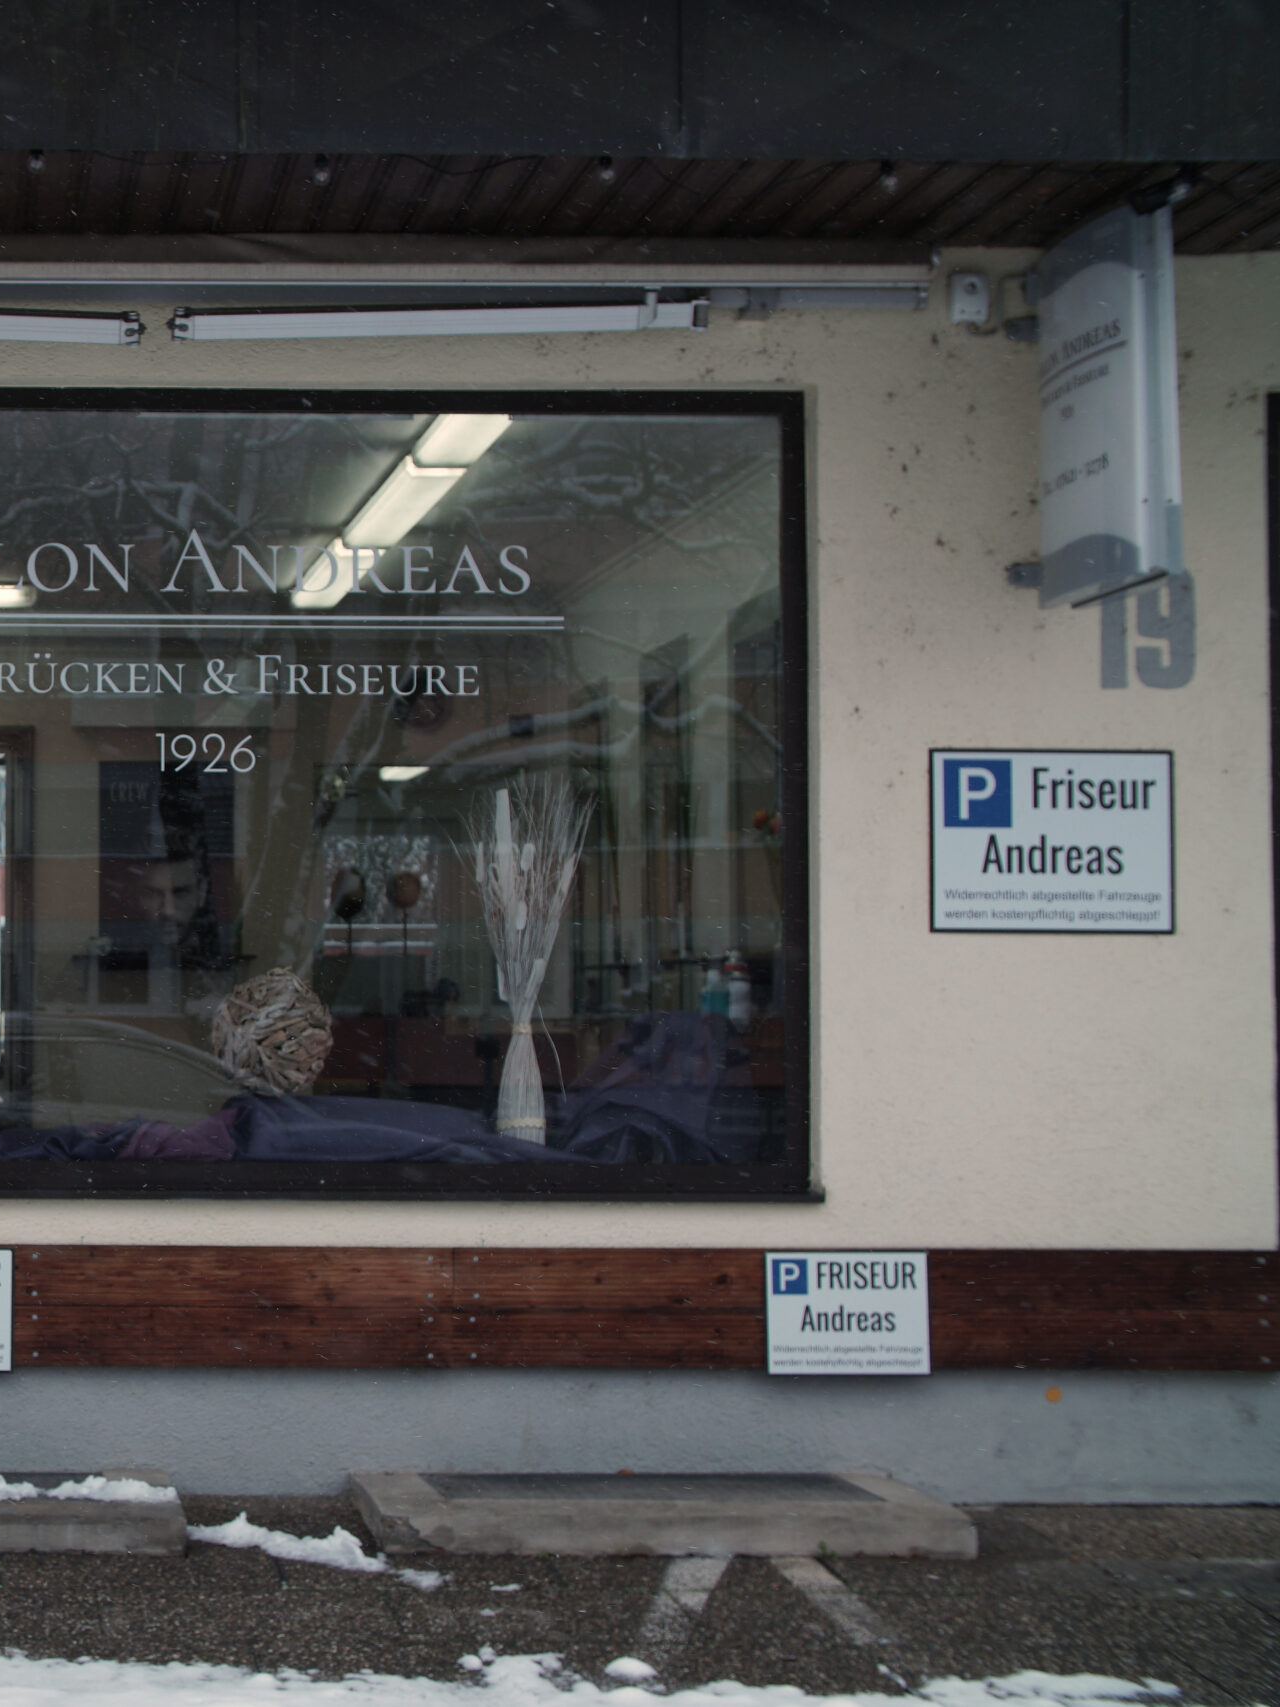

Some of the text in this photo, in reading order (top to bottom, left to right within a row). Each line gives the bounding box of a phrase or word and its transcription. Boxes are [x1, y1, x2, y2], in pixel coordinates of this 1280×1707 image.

[160, 528, 532, 595] ANDREAS
[1101, 567, 1197, 689] 19
[203, 658, 240, 695] &
[256, 654, 480, 696] FRISEURE
[155, 732, 256, 773] 1926
[958, 767, 997, 820] P
[1032, 767, 1157, 810] Friseur
[982, 834, 1124, 875] Andreas
[944, 889, 1162, 904] Widerrechtlich abgestellte Fahrzeuge
[944, 909, 988, 920] werden
[991, 909, 1075, 922] kostenpflichtig
[779, 1262, 801, 1292] P
[816, 1261, 917, 1290] FRISEUR
[800, 1304, 896, 1333] Andreas
